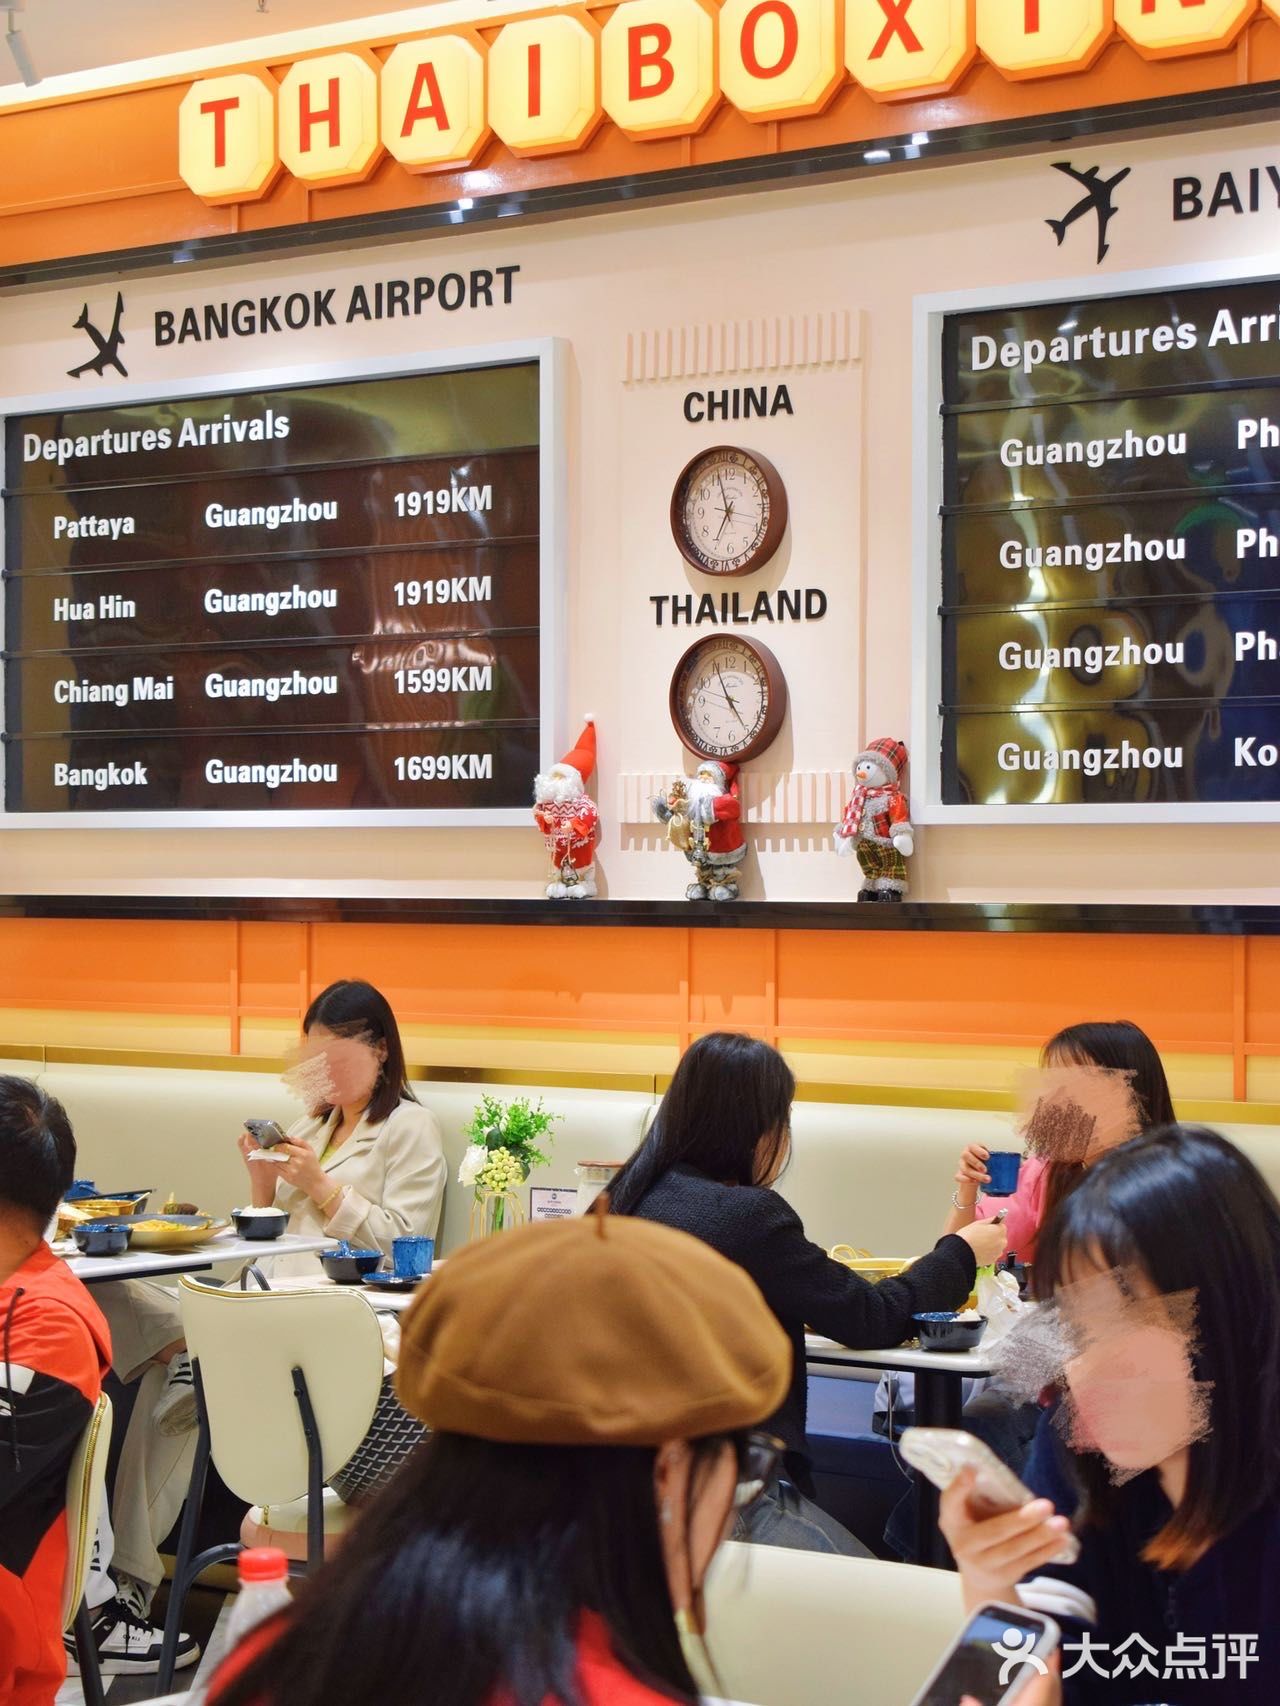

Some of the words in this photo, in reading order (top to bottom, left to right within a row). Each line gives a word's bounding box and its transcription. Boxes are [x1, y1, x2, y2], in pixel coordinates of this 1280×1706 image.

[154, 288, 336, 347] BANGKOK
[346, 265, 521, 323] AIRPORT
[971, 320, 1197, 374] Departures
[1208, 309, 1280, 347] Arr
[684, 384, 794, 423] CHINA
[23, 427, 172, 466] Departures
[178, 409, 290, 448] Arrivals
[1000, 429, 1187, 469] Guangzhou
[54, 515, 135, 541] Pattaya
[205, 497, 338, 531] Guangzhou
[394, 485, 492, 518] 1919KM
[999, 533, 1186, 573] Guangzhou
[54, 598, 95, 622] Hua
[100, 595, 136, 620] Hin
[204, 584, 337, 617] Guangzhou
[394, 575, 492, 606] 1919KM
[649, 588, 828, 626] THAILAND
[998, 636, 1185, 676] Guangzhou
[1235, 630, 1280, 662] Ph
[54, 679, 129, 707] Chiang
[133, 676, 174, 701] Mai
[205, 670, 338, 703] Guangzhou
[394, 665, 492, 694] 1599KM
[54, 761, 148, 791] Bangkok
[205, 757, 338, 789] Guangzhou
[394, 753, 492, 781] 1699KM
[997, 740, 1183, 777] Guangzhou
